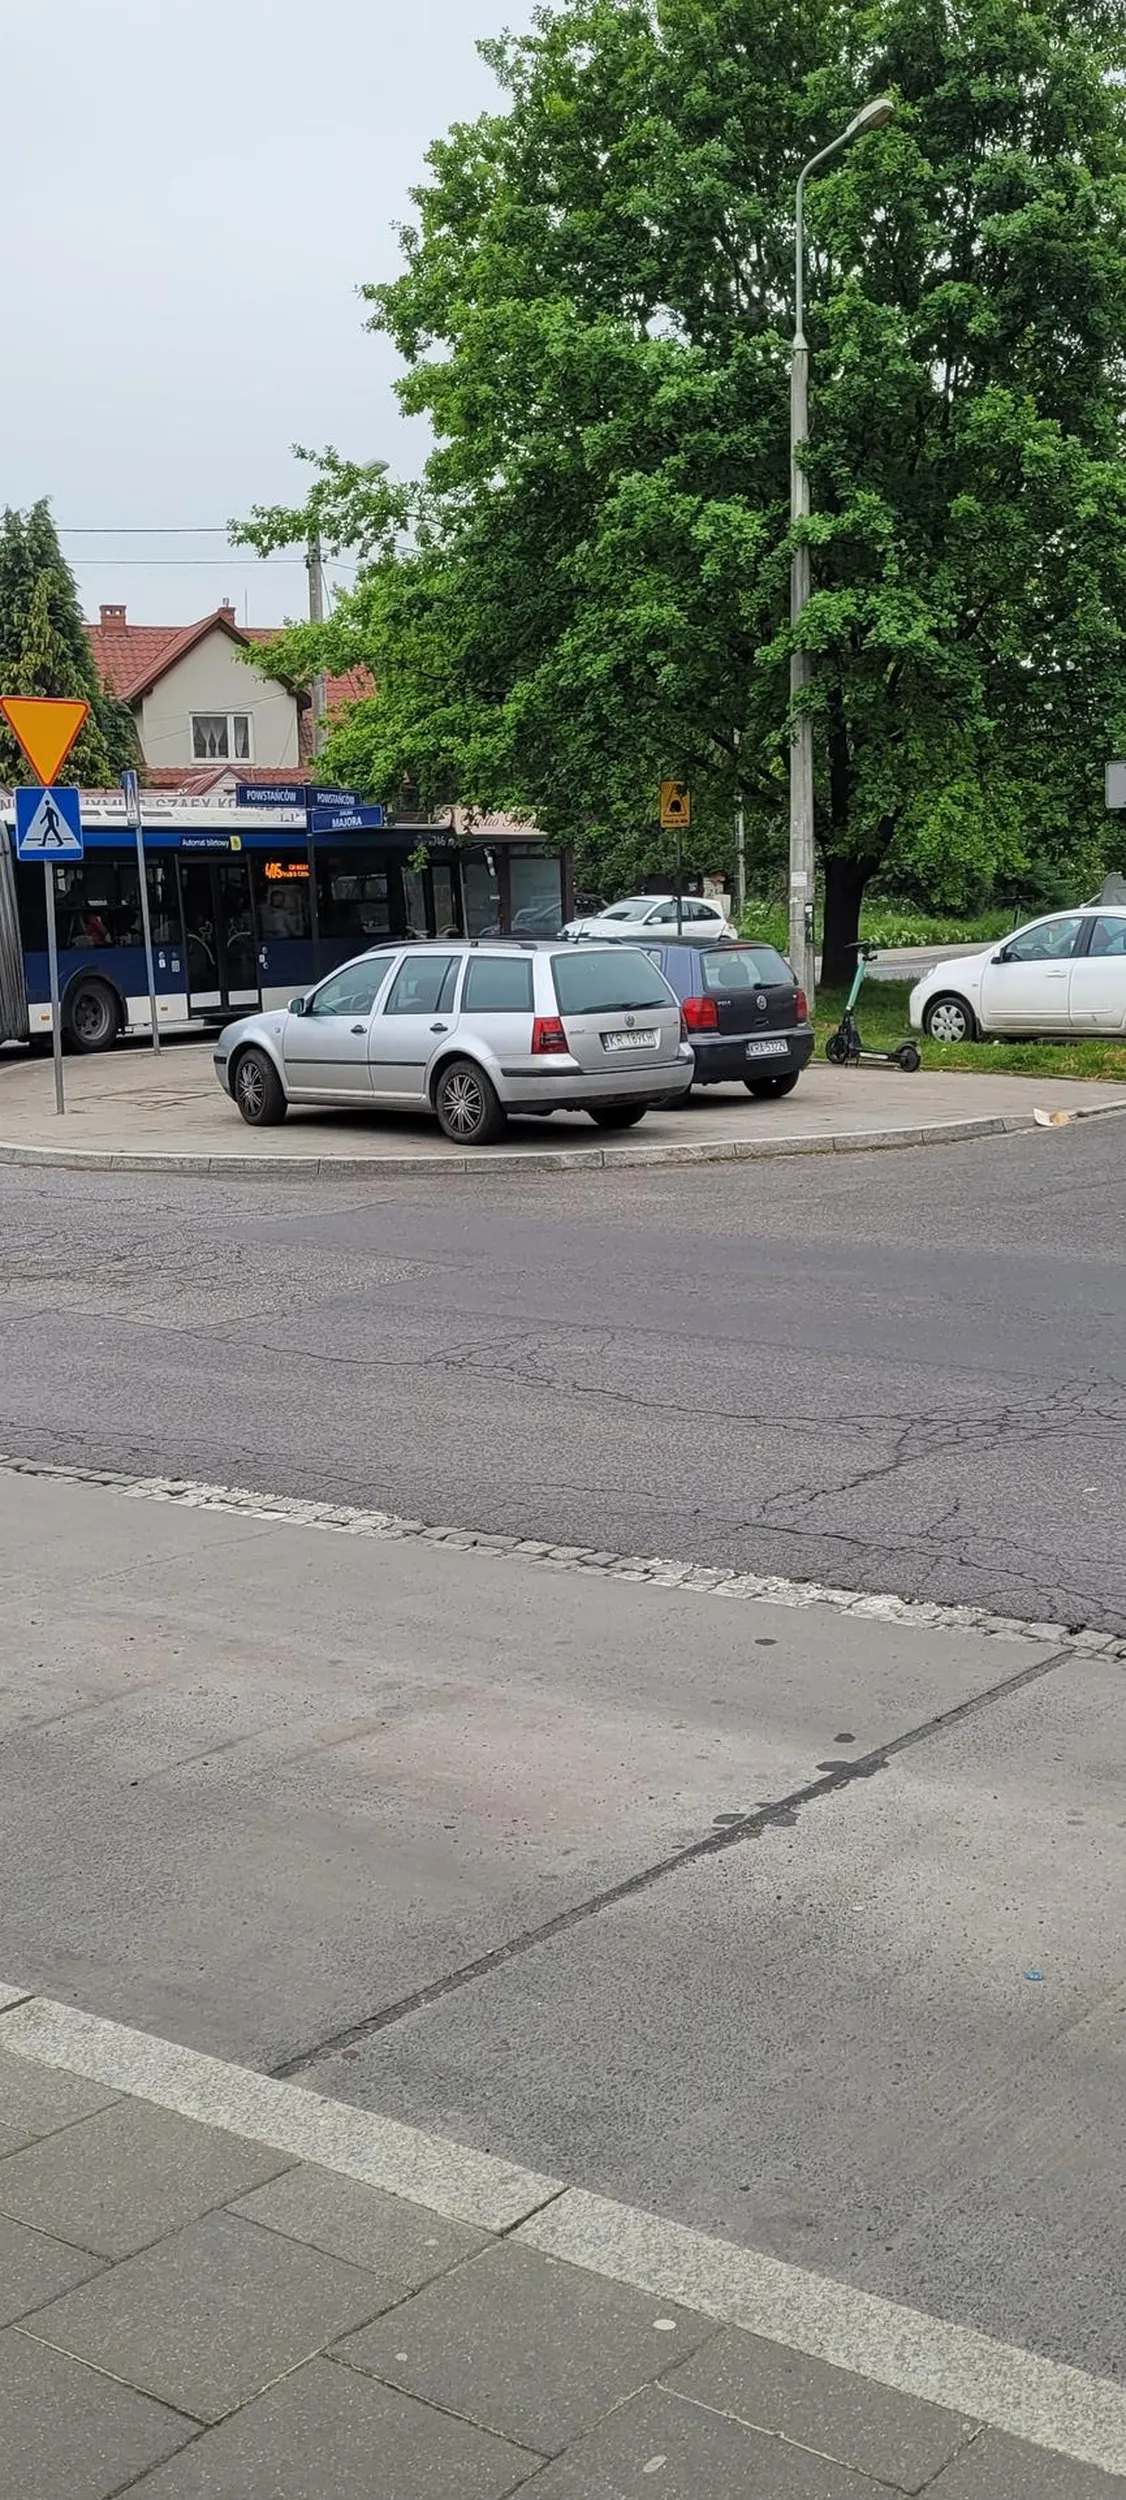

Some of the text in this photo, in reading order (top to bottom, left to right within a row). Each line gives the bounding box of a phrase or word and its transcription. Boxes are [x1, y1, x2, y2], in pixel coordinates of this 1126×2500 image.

[246, 788, 297, 802] POWSTAŃCÓW
[316, 791, 355, 805] POWSTAŃCÓW
[332, 815, 362, 828] MAJORA
[265, 862, 282, 879] 405
